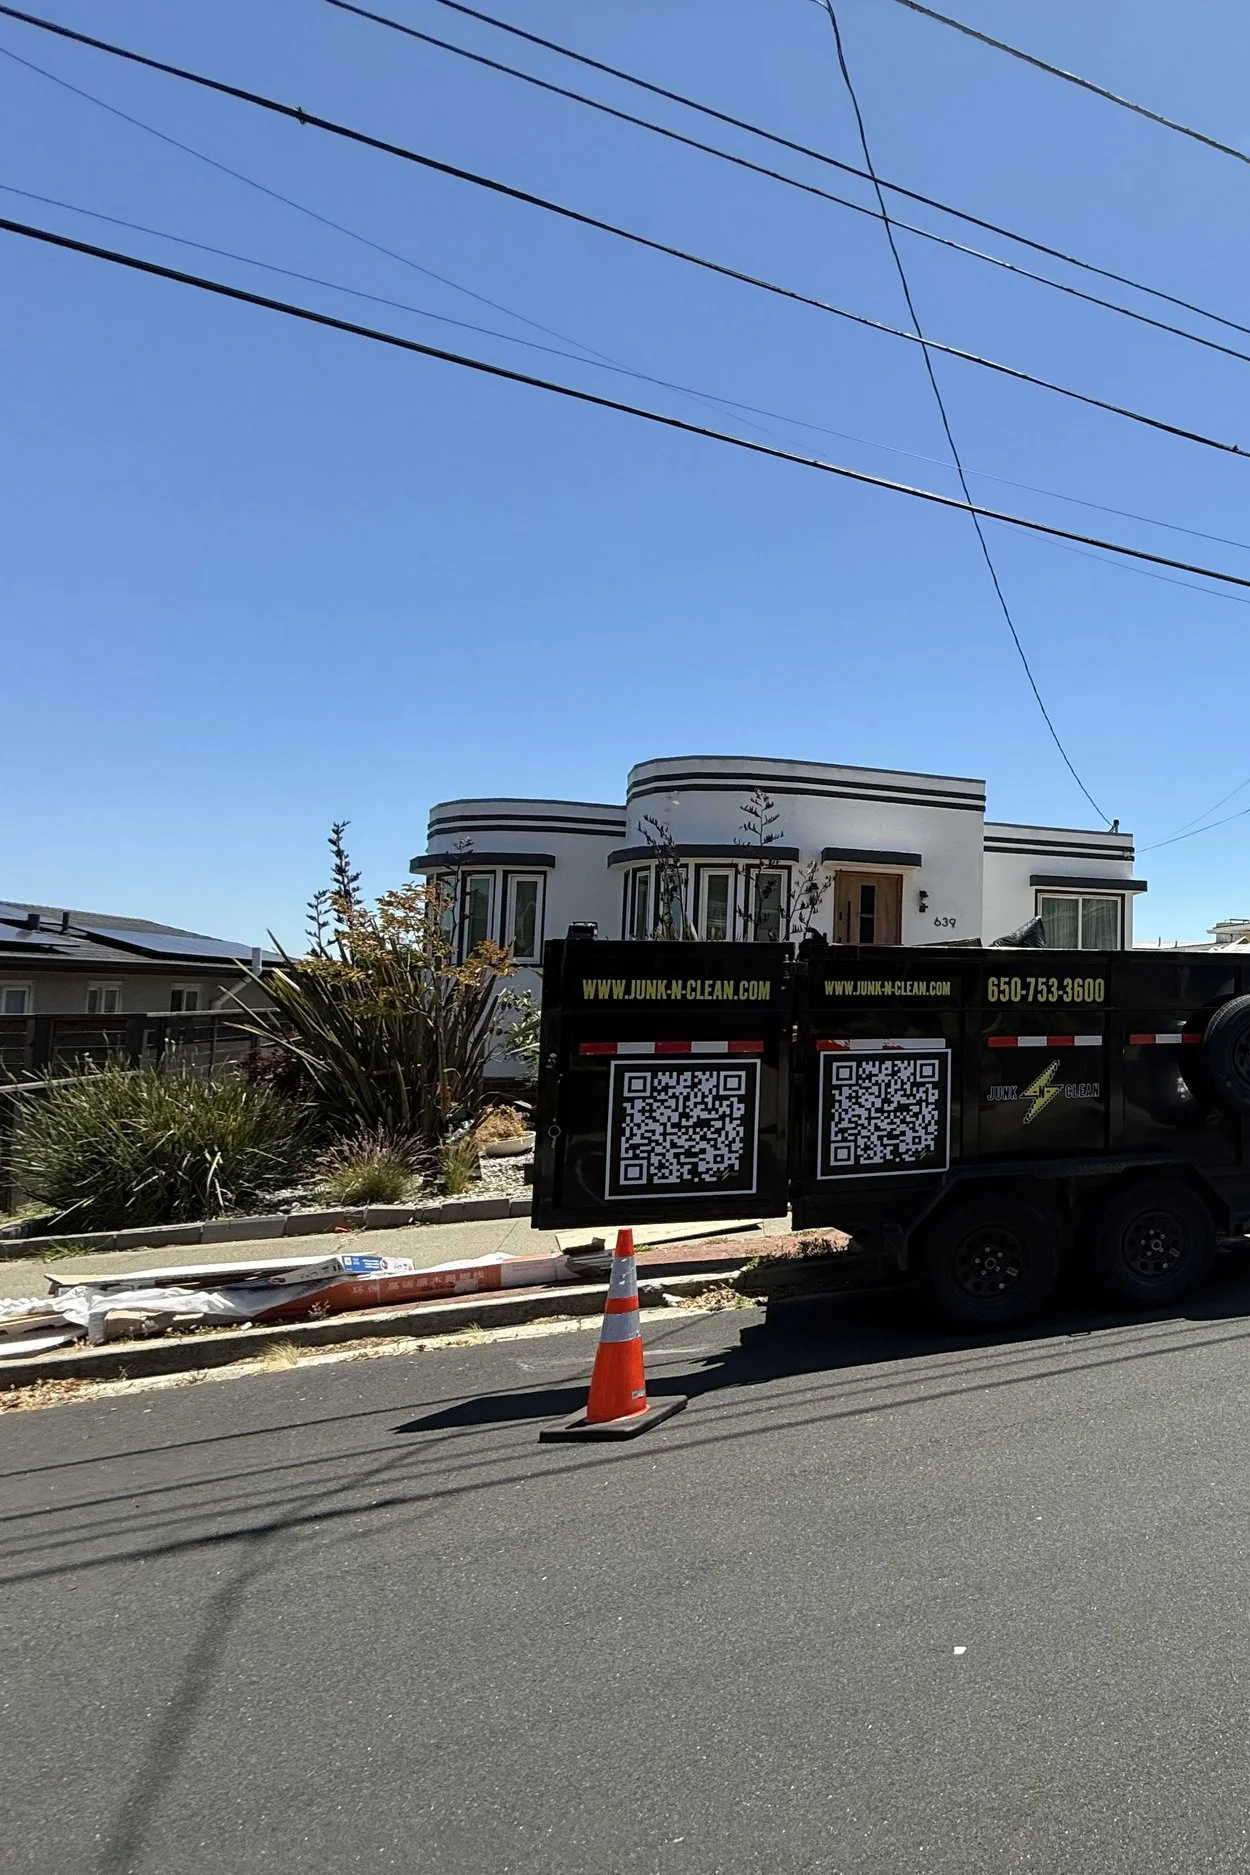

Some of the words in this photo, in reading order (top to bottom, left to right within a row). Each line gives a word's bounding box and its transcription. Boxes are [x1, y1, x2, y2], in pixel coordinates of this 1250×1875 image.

[934, 917, 956, 928] 639
[582, 978, 771, 1001] WWW.JUNK-N-CLEAN.COM
[824, 980, 951, 996] WWW.JUNK-N-CLEAN.COM
[987, 976, 1105, 1003] 650-753-3600
[987, 1085, 1018, 1101] JUNK
[1065, 1083, 1100, 1098] CLEAN
